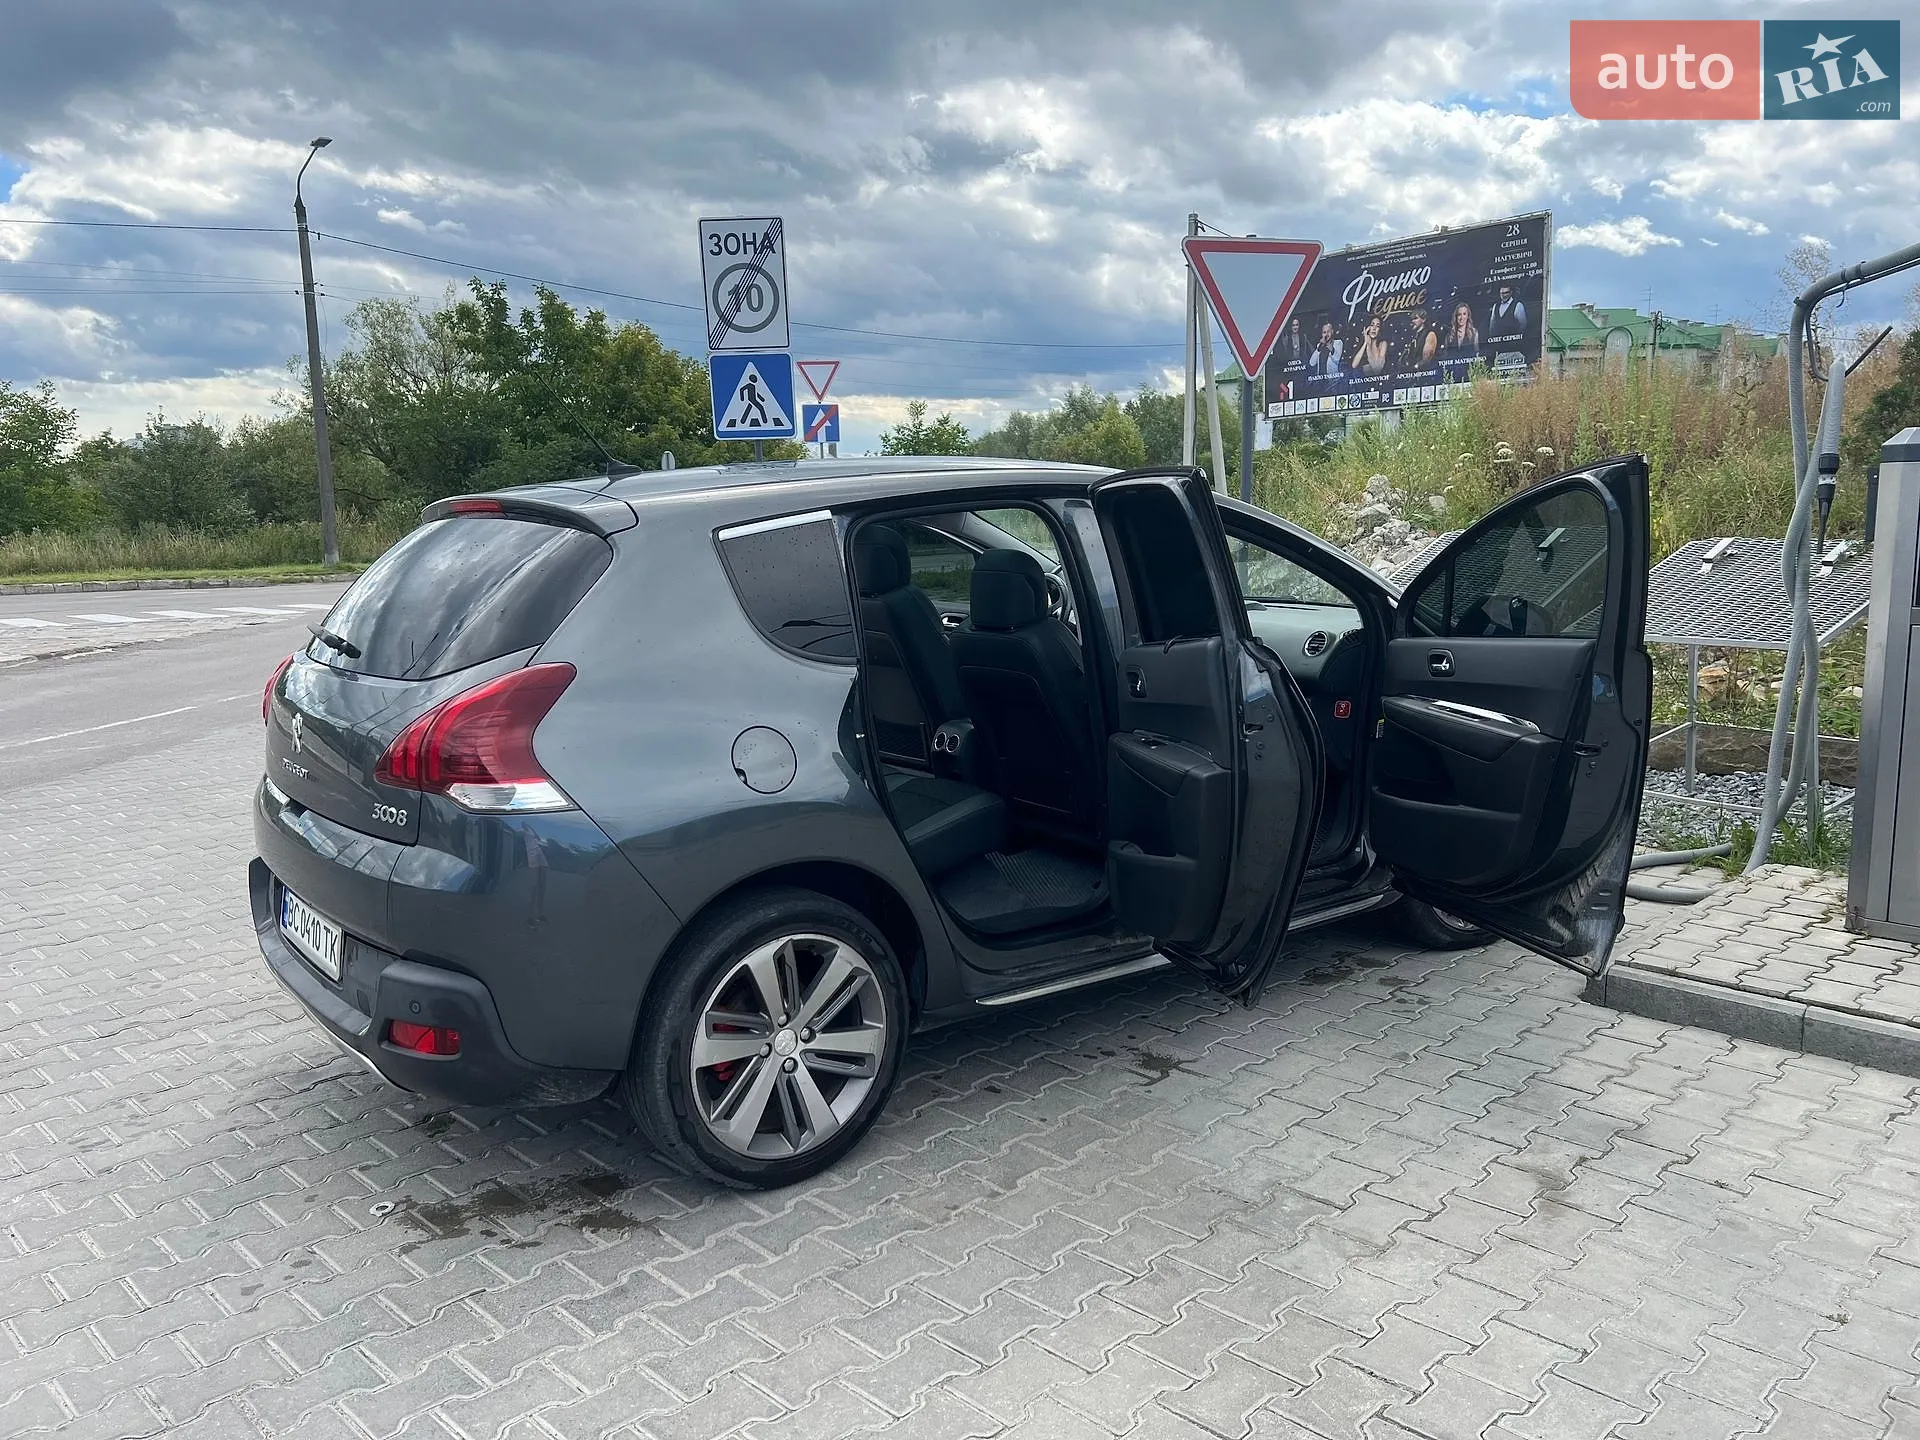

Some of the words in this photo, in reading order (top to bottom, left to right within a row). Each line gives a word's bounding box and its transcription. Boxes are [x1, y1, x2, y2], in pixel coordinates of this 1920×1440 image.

[1506, 223, 1520, 237] 28
[708, 232, 777, 257] ЗОНА
[727, 283, 764, 313] 10
[1342, 266, 1432, 322] Франко
[371, 802, 408, 827] 3008
